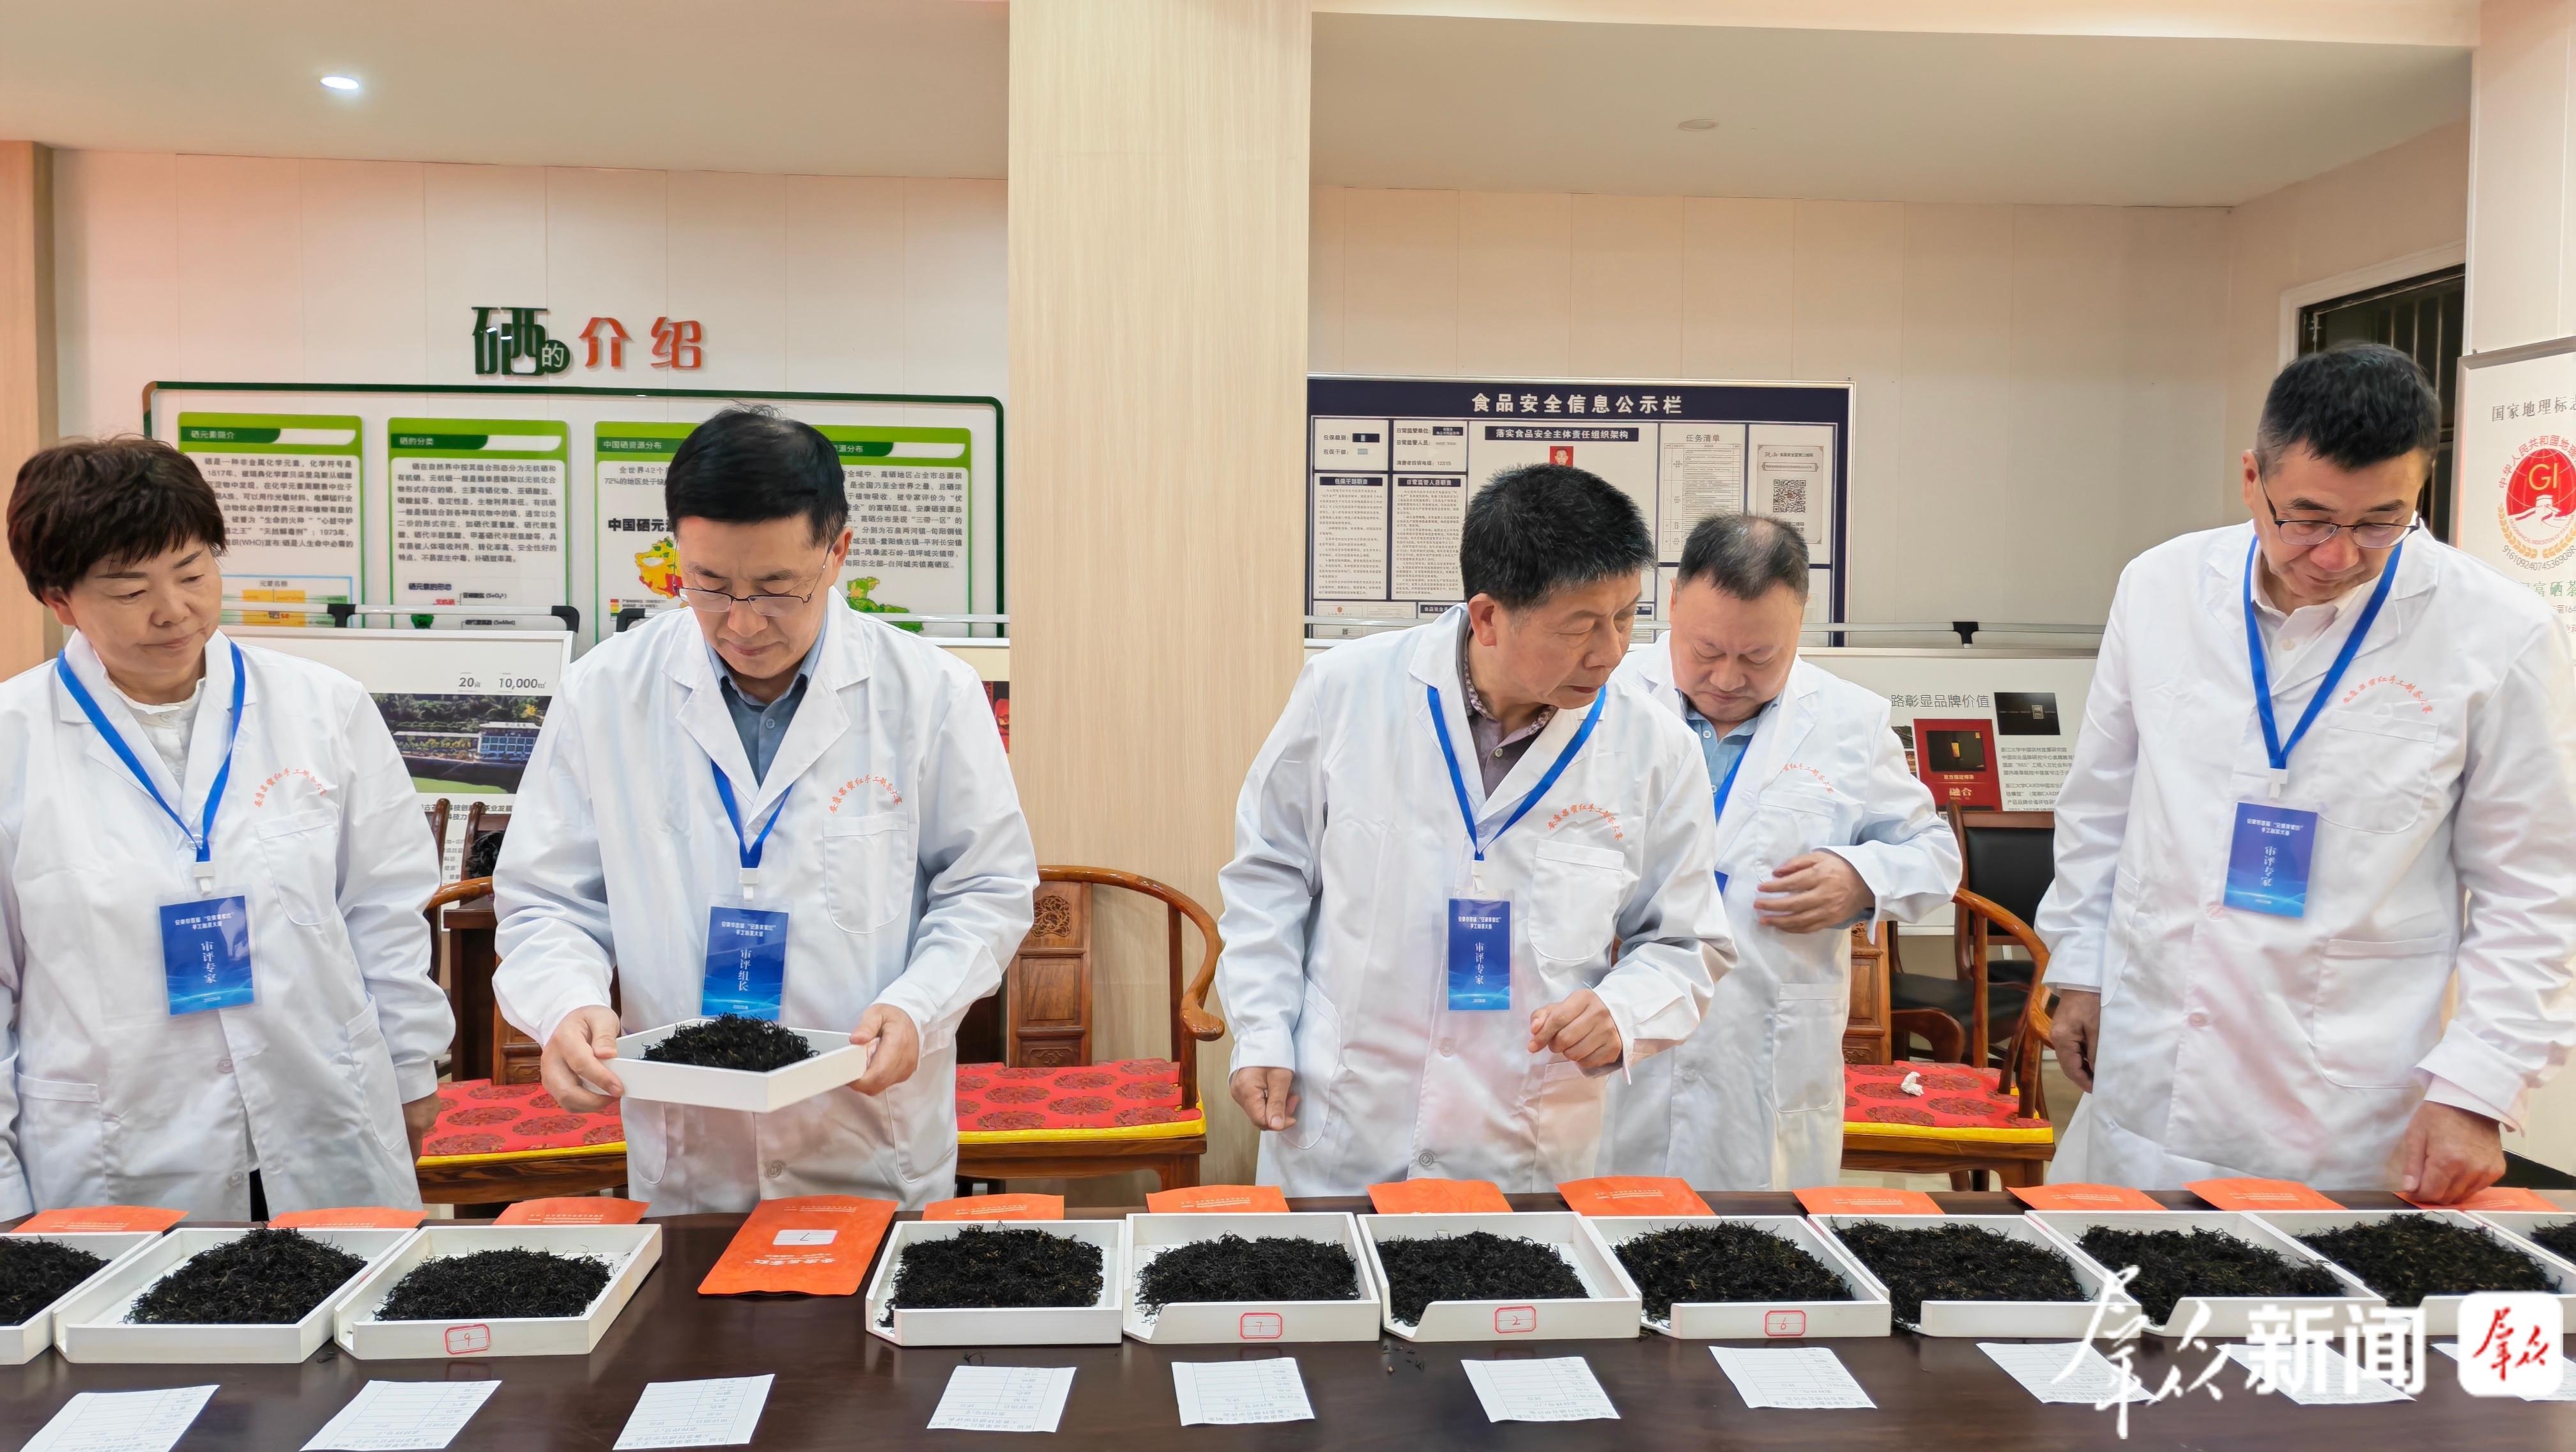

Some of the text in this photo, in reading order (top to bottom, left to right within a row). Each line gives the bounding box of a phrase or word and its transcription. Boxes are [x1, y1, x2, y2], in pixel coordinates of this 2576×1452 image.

[1471, 393, 1682, 414] 食品安全信息公示栏
[191, 429, 234, 439] 硒元素简介
[1496, 428, 1629, 439] 落实食品安全主体责任组织架构
[1686, 434, 1721, 442] 任务清单
[399, 437, 434, 445] 硒的分类
[603, 440, 662, 450] 中国硒资源分布
[2529, 463, 2557, 490] GI
[1891, 694, 1991, 708] 路彰显品牌价值
[1512, 1315, 1521, 1326] 2
[1255, 1320, 1263, 1334] 7
[464, 1332, 471, 1347] 9
